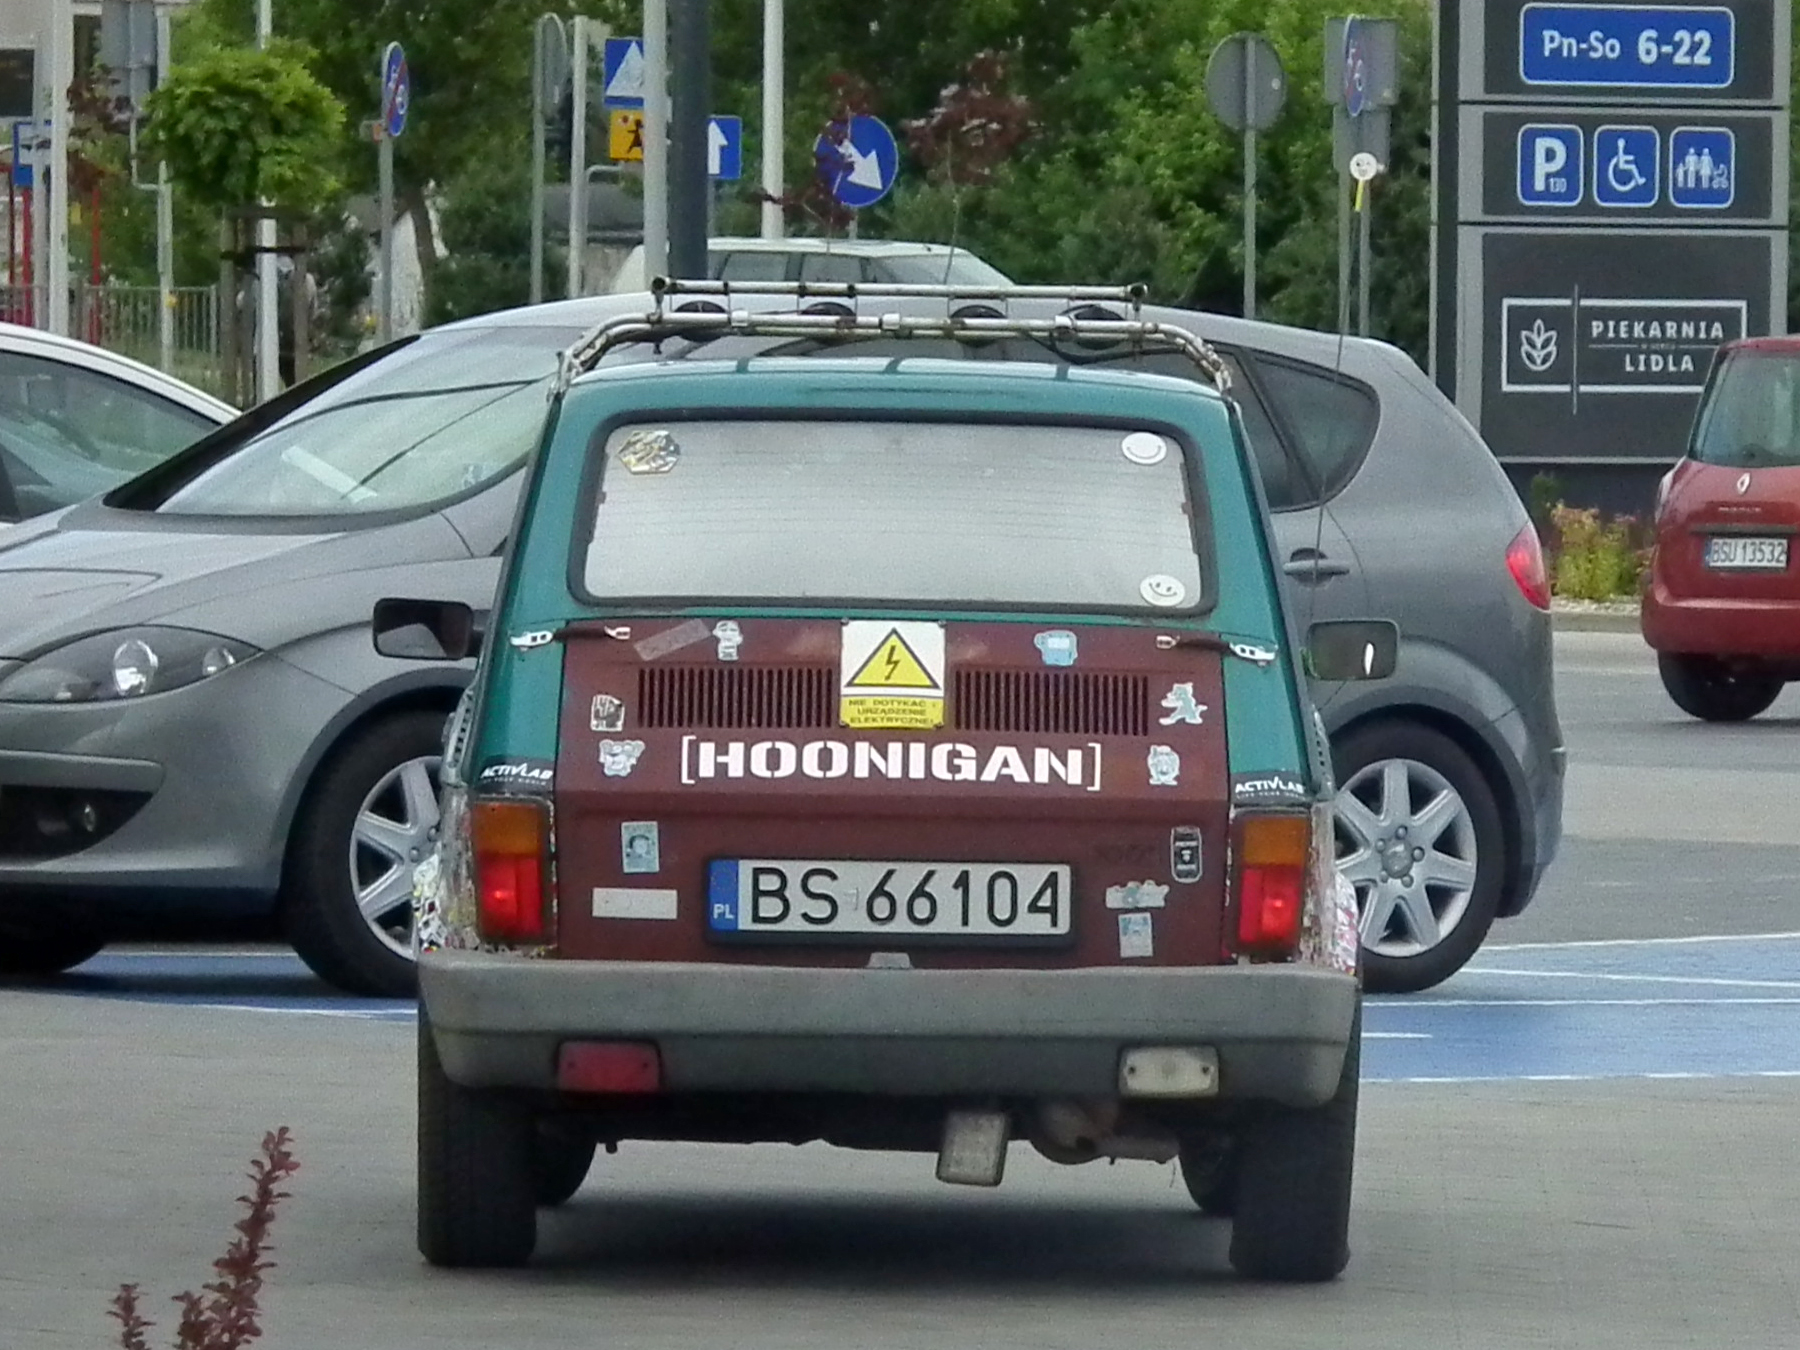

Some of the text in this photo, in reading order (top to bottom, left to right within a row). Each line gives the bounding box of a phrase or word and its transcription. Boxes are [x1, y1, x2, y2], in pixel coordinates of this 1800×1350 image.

[1542, 28, 1712, 65] Pn-So 6-22
[1534, 137, 1567, 192] P
[1591, 320, 1724, 339] PIEKARNIA
[1625, 353, 1694, 372] LIDLA
[1712, 541, 1784, 563] BSU 13532
[480, 763, 553, 779] ACTIVLAB
[1235, 776, 1304, 794] ACTIVLAB
[751, 866, 1059, 928] BS 66104
[713, 903, 735, 919] PL
